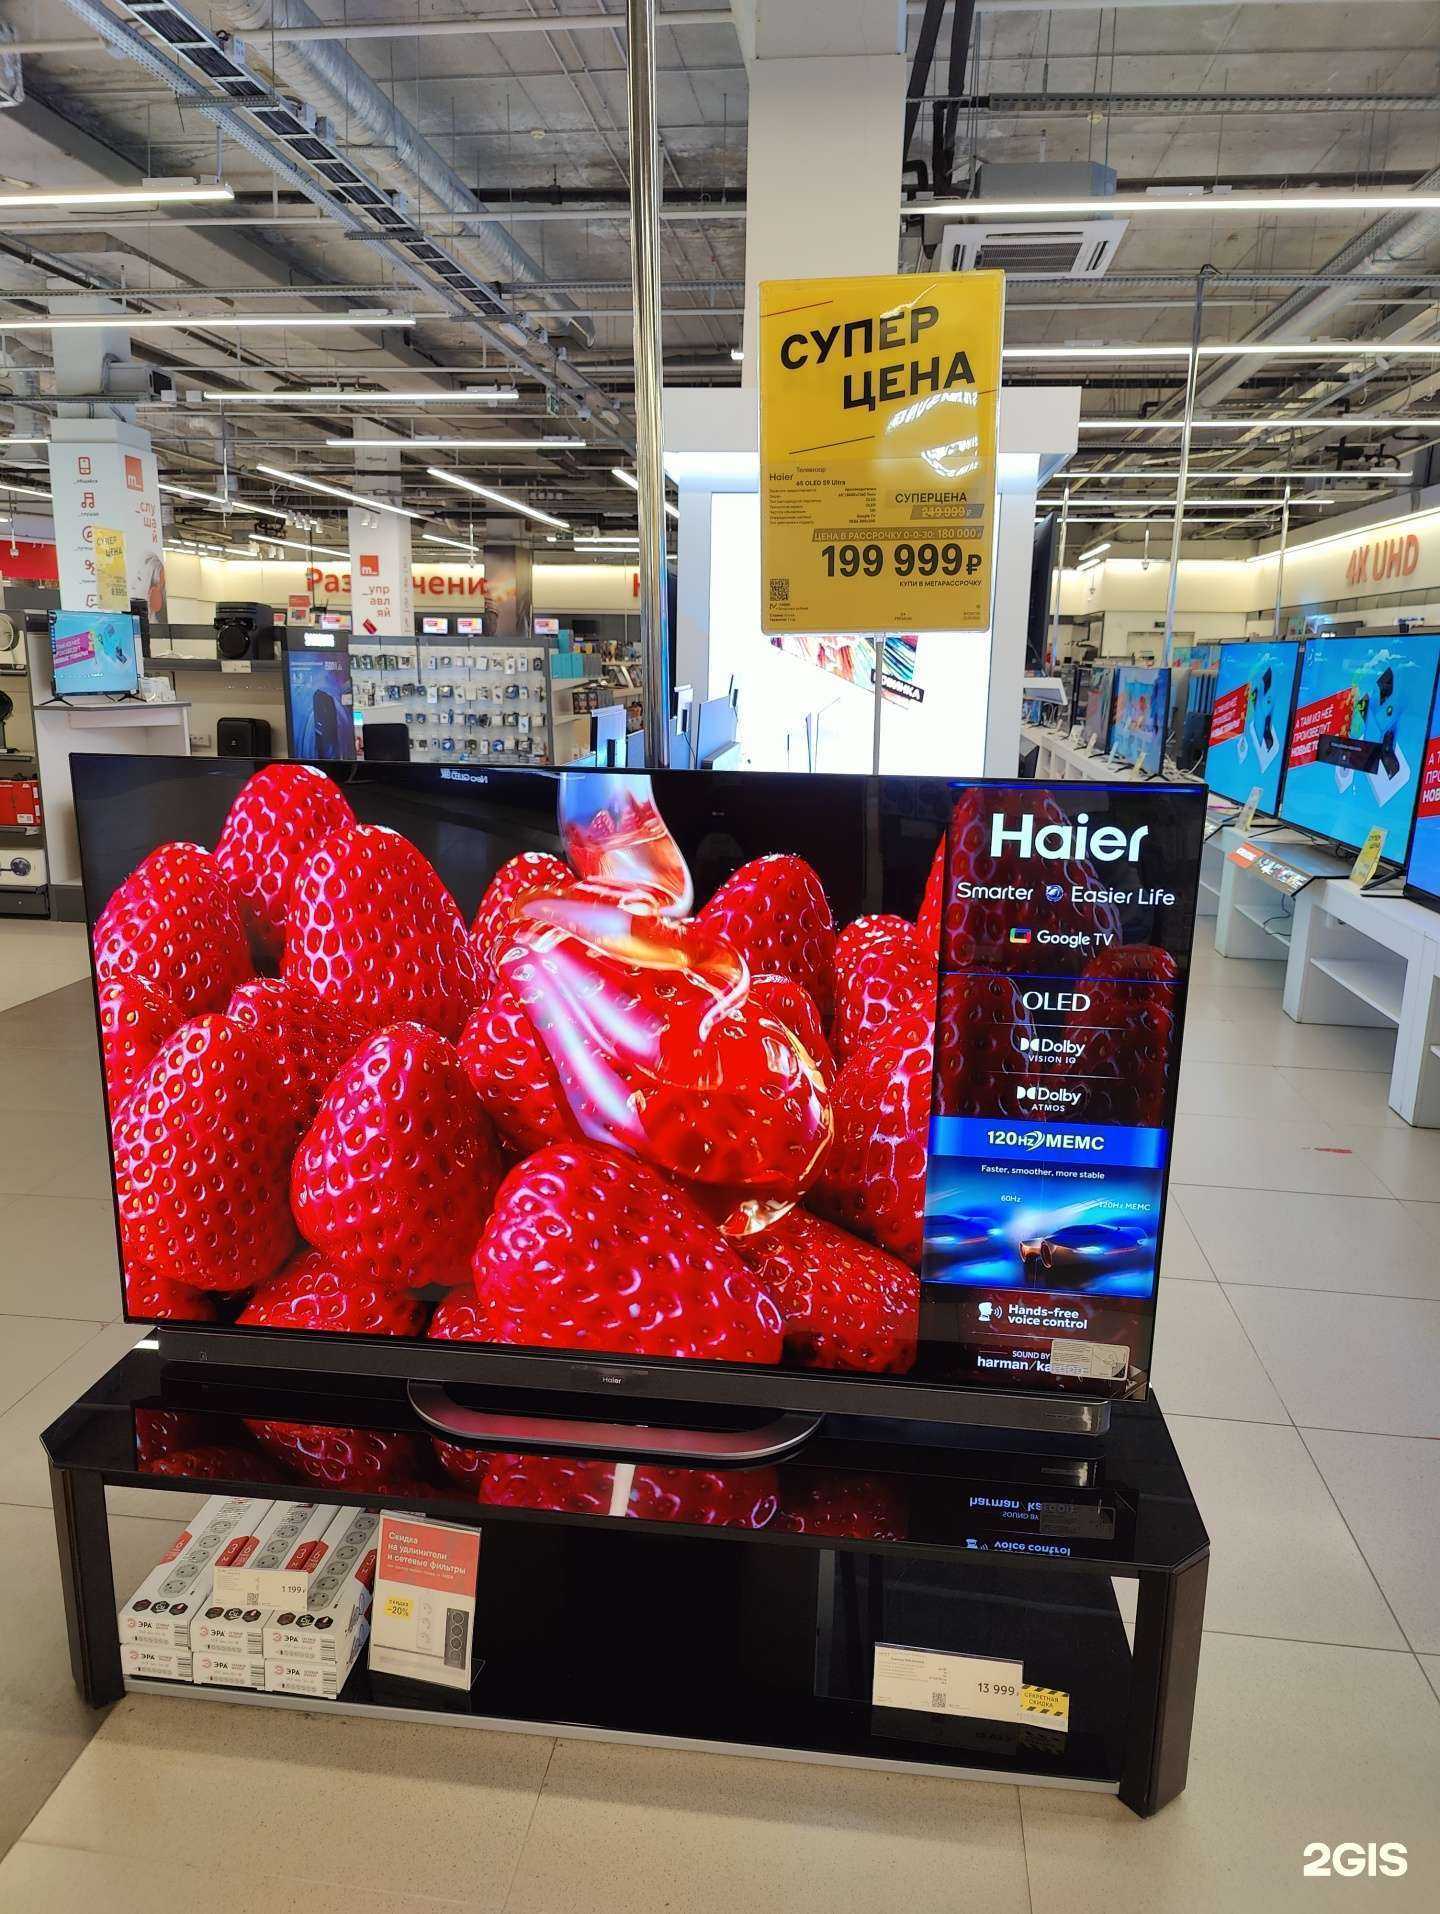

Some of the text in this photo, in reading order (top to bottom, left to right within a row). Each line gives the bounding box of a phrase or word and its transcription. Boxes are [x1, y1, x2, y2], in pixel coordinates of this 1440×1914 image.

[780, 305, 940, 370] СУПЕР
[842, 350, 976, 412] ЦЕНА
[769, 473, 795, 482] Haier
[895, 492, 967, 504] СУПЕРЦЕНА
[814, 532, 841, 541] ЦЕНА
[849, 530, 901, 540] РАССРОЧКУ
[937, 530, 954, 539] 180
[821, 544, 884, 577] 199
[1346, 534, 1420, 586] 4K UHD
[924, 580, 982, 588] МЕГАРАССРОЧКУ
[1428, 752, 1436, 766] А
[990, 812, 1149, 862] Haier
[956, 882, 1175, 906] Smarter Easier Life
[1036, 929, 1114, 948] Google TV
[1022, 991, 1091, 1012] OLED
[1041, 1038, 1086, 1057] Dolby
[1028, 1055, 1077, 1064] VISION IQ
[1037, 1087, 1082, 1105] Dolby
[1031, 1103, 1066, 1112] ATMOS
[1046, 1134, 1105, 1150] MEMC
[1055, 1170, 1078, 1178] more
[1079, 1170, 1105, 1180] stable
[1000, 1195, 1023, 1203] 60Hz
[1125, 1202, 1151, 1211] MEMC
[1008, 1303, 1080, 1319] Hands-free
[1007, 1315, 1088, 1330] voice control
[1012, 1350, 1051, 1360] SOUND BY
[388, 1531, 419, 1545] Скидка
[226, 1543, 240, 1554] 3
[296, 1548, 307, 1559] 3
[387, 1543, 448, 1560] на удлинители
[394, 1555, 429, 1568] сетевые
[429, 1560, 467, 1576] фильтры
[137, 1621, 152, 1629] ЭРА
[284, 1635, 299, 1643] ЭРА
[286, 1668, 300, 1676] ЭРА
[977, 1682, 990, 1694] 13
[1024, 1692, 1059, 1703] СЕКРЕТНАЯ
[1028, 1699, 1053, 1708] СКИДКА
